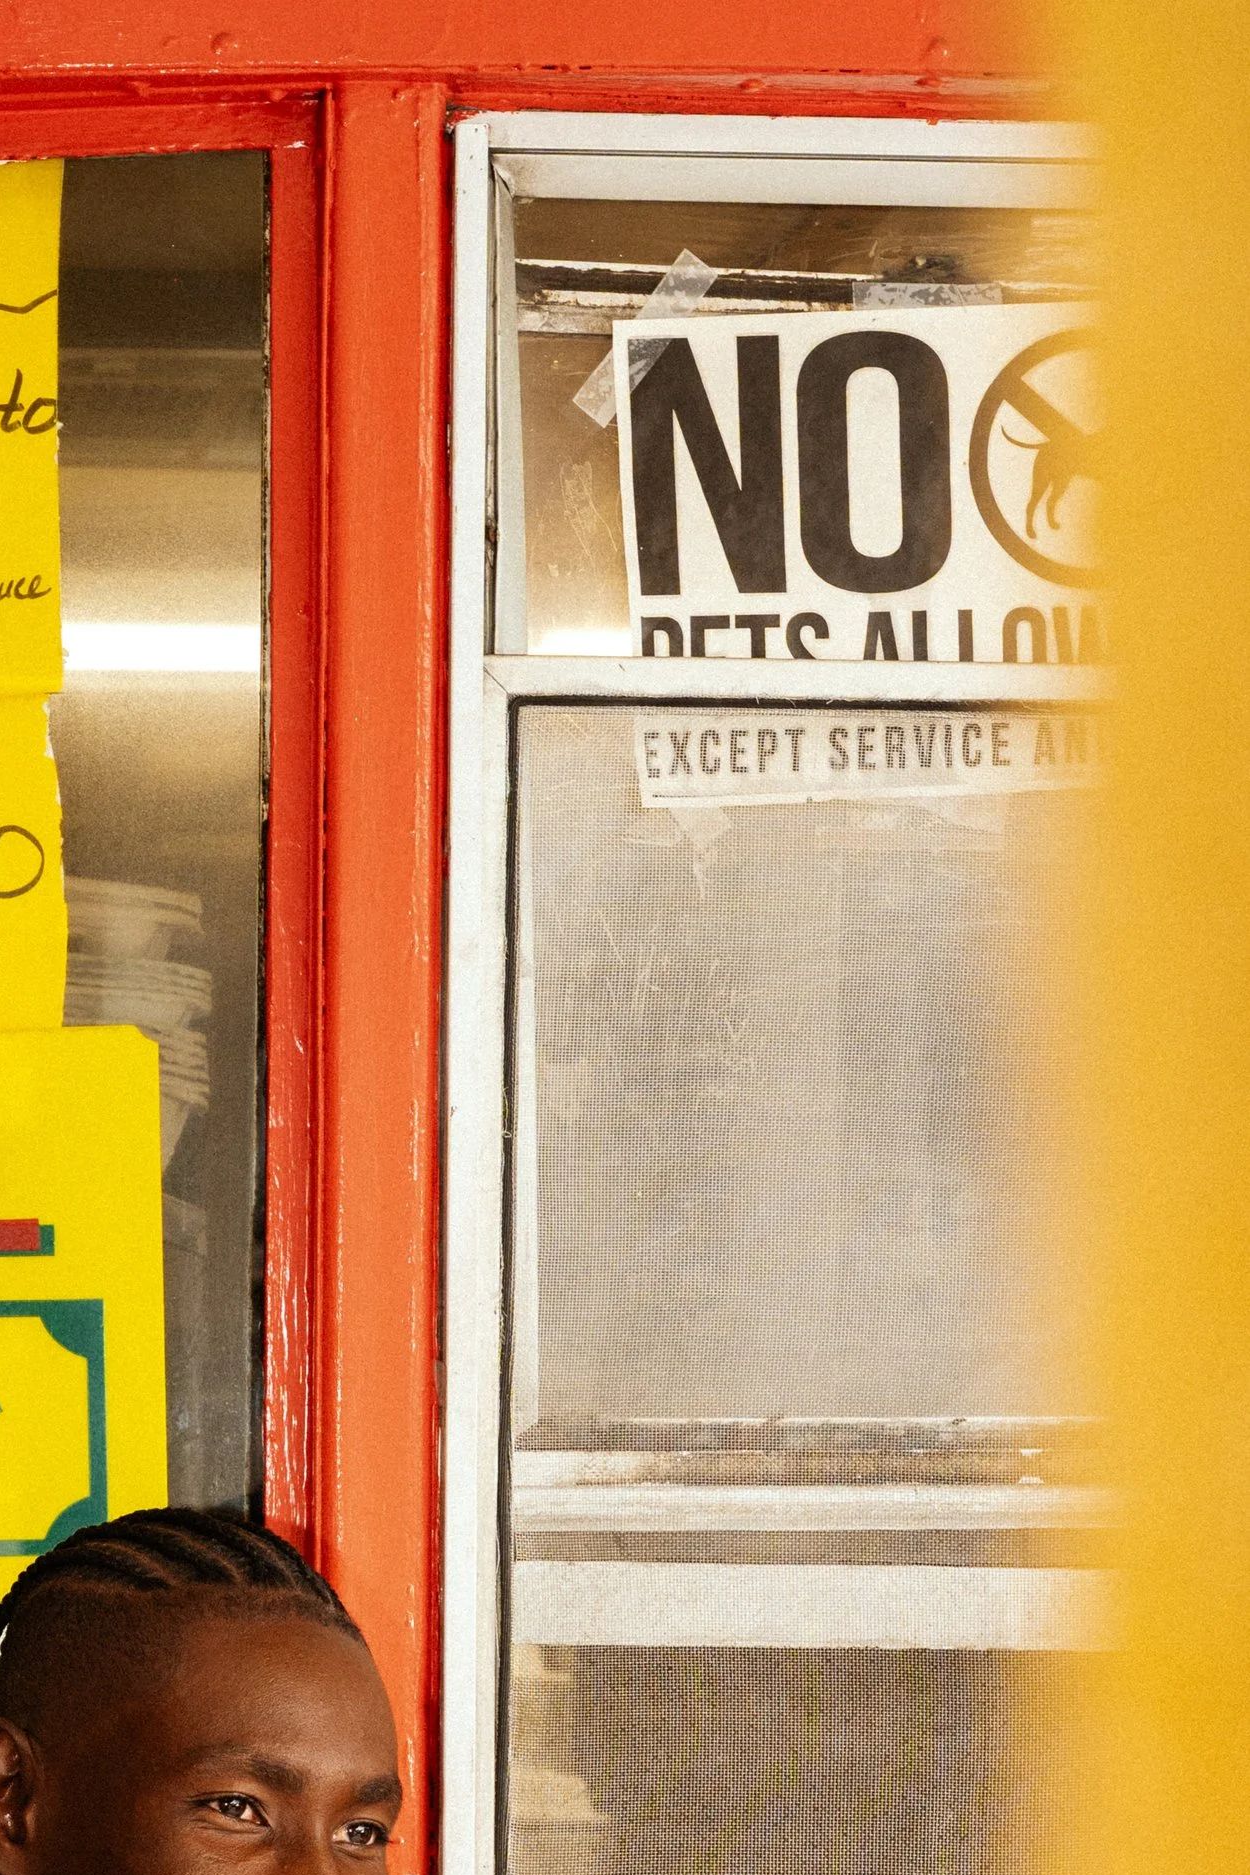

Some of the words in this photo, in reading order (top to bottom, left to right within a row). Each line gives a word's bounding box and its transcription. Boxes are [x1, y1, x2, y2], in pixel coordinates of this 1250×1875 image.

[627, 331, 952, 596] NO
[643, 727, 805, 779] EXCEPT
[828, 722, 1012, 773] SERVICE
